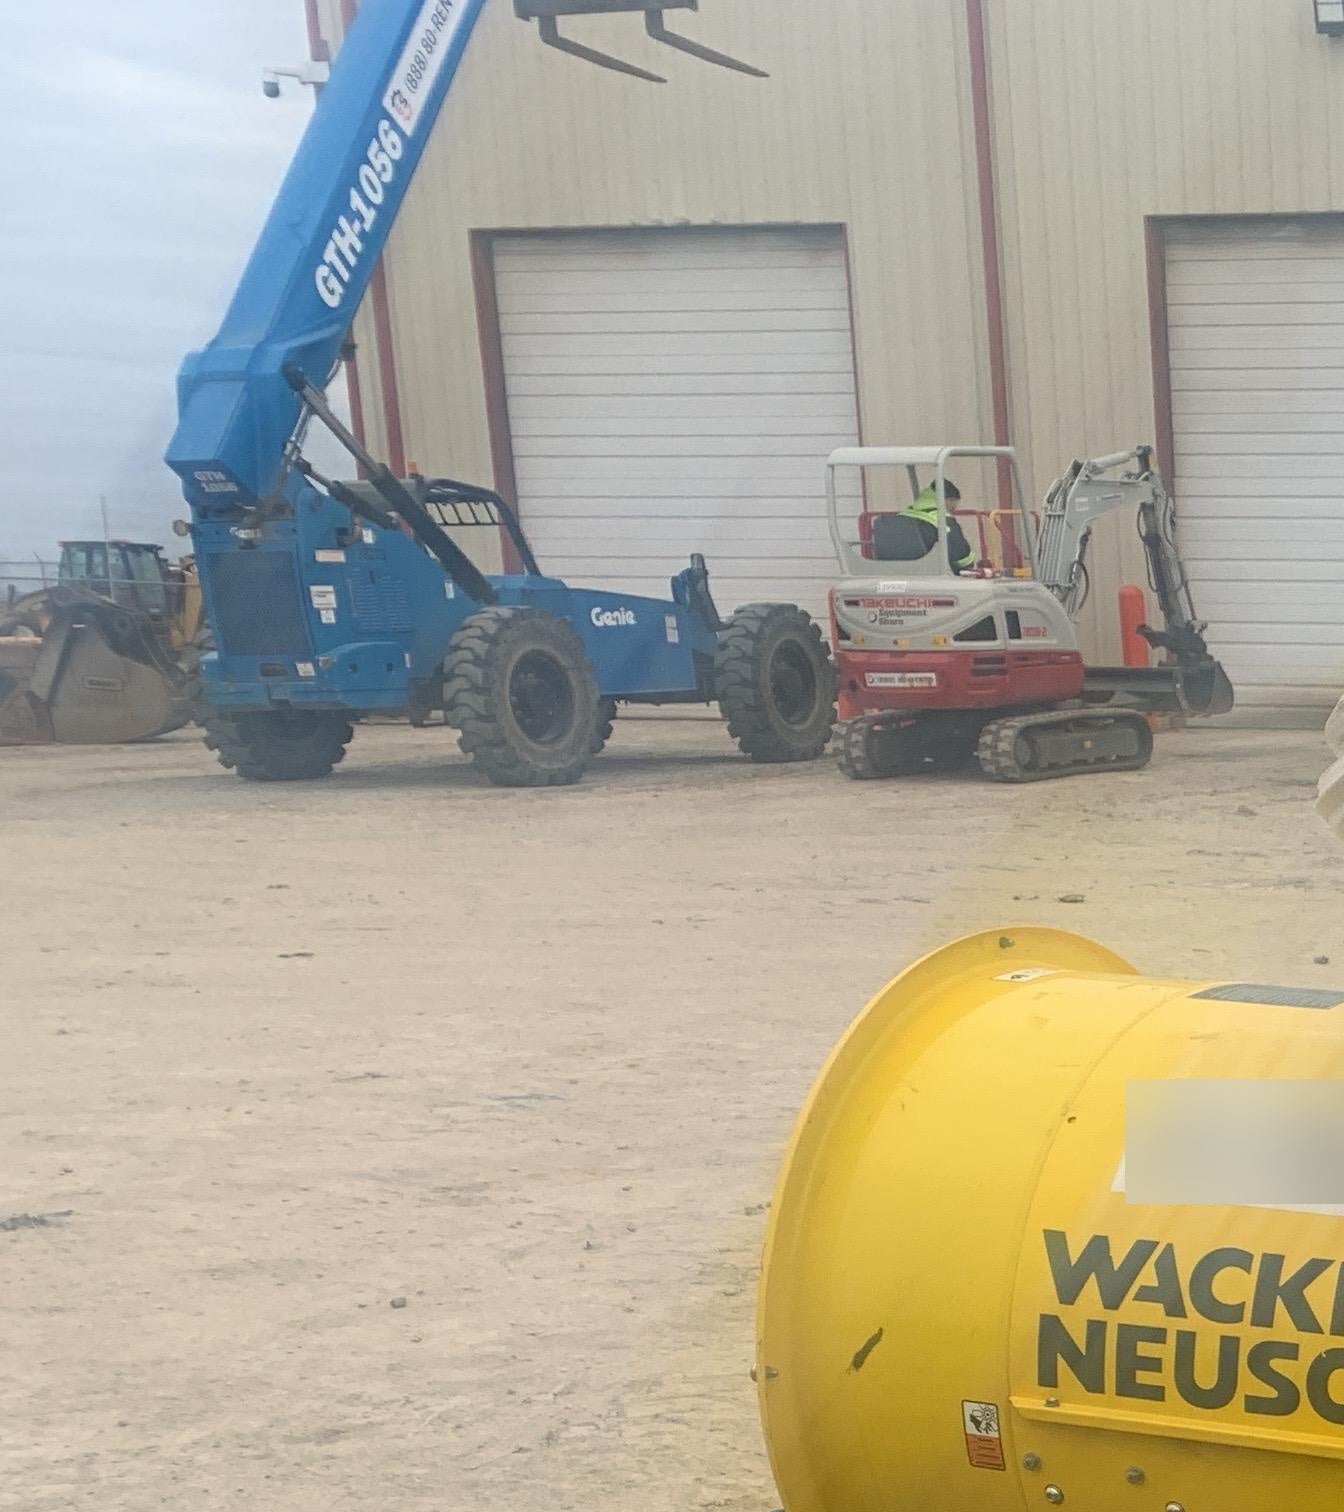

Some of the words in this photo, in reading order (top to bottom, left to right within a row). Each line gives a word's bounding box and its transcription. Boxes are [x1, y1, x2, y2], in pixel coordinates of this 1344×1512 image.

[404, 49, 428, 94] (888)
[315, 119, 403, 308] GTH-1056
[591, 606, 638, 627] Genie
